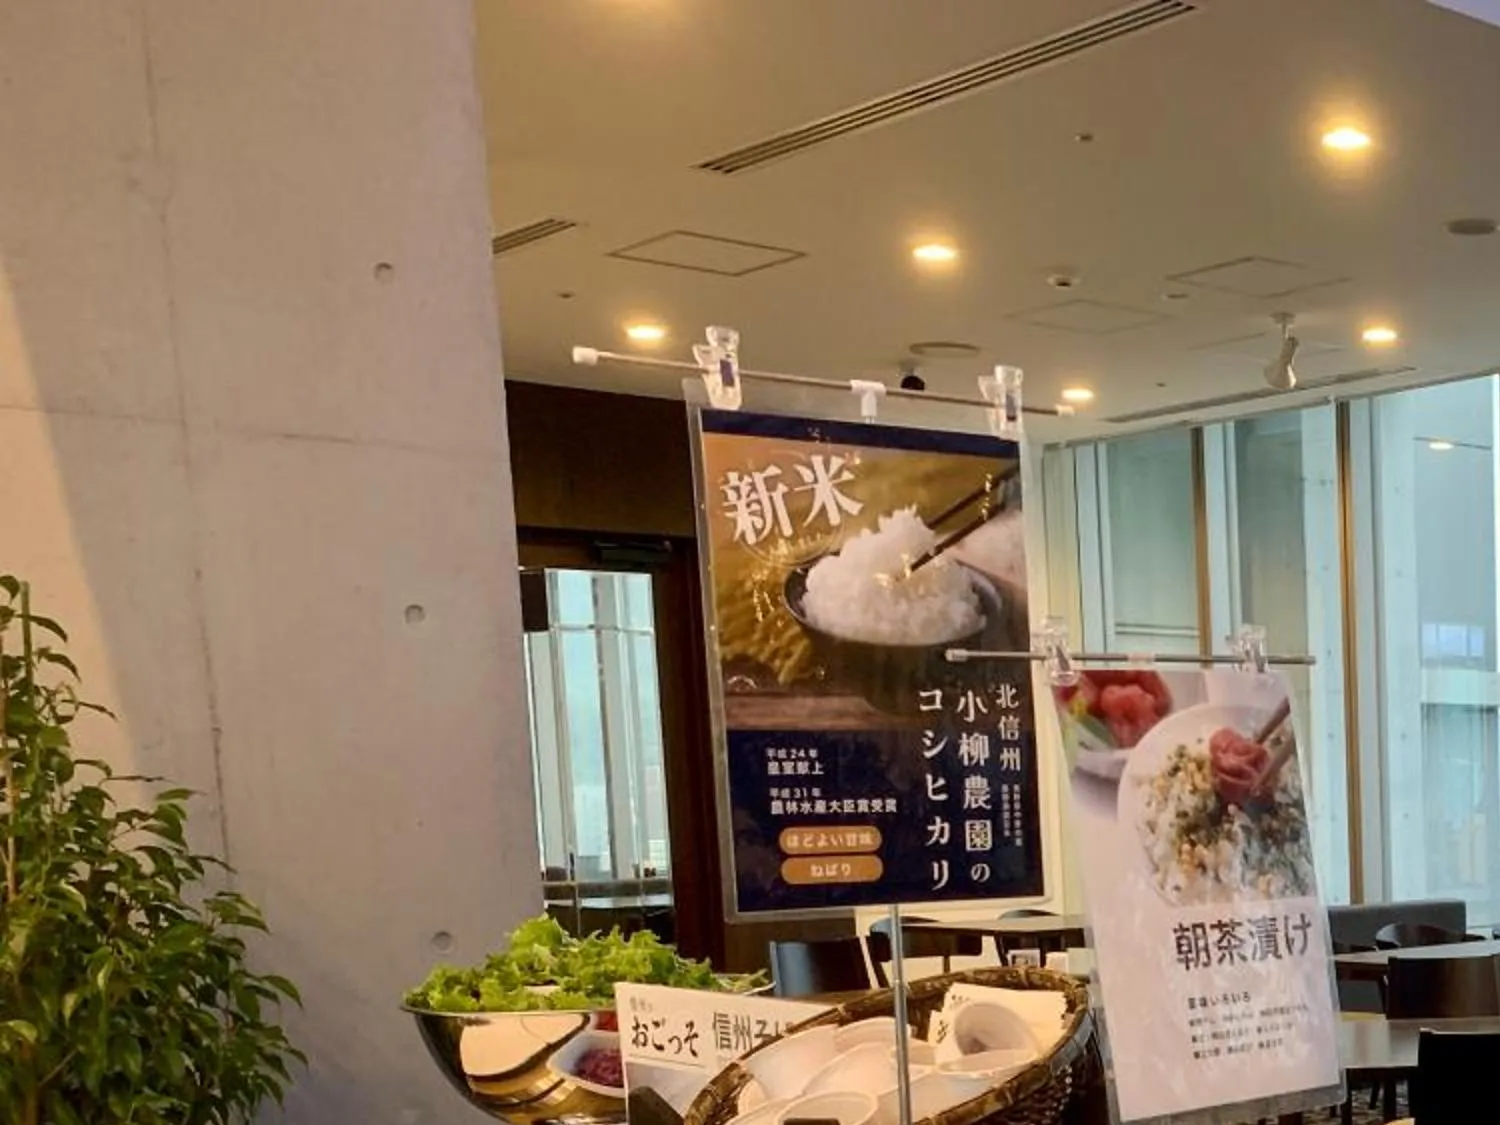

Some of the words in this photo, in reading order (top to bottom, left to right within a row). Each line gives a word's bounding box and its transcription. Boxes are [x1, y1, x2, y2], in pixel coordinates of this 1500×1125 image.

[720, 454, 864, 545] 新米
[996, 684, 1020, 771] 北信州
[771, 799, 897, 815] 農林水産大臣賞受賞
[919, 688, 951, 890] コシヒカリ
[957, 689, 992, 882] 小柳農園の
[810, 863, 852, 877] ねばり
[1173, 913, 1312, 972] 朝茶漬け
[631, 1014, 699, 1058] おごっそ
